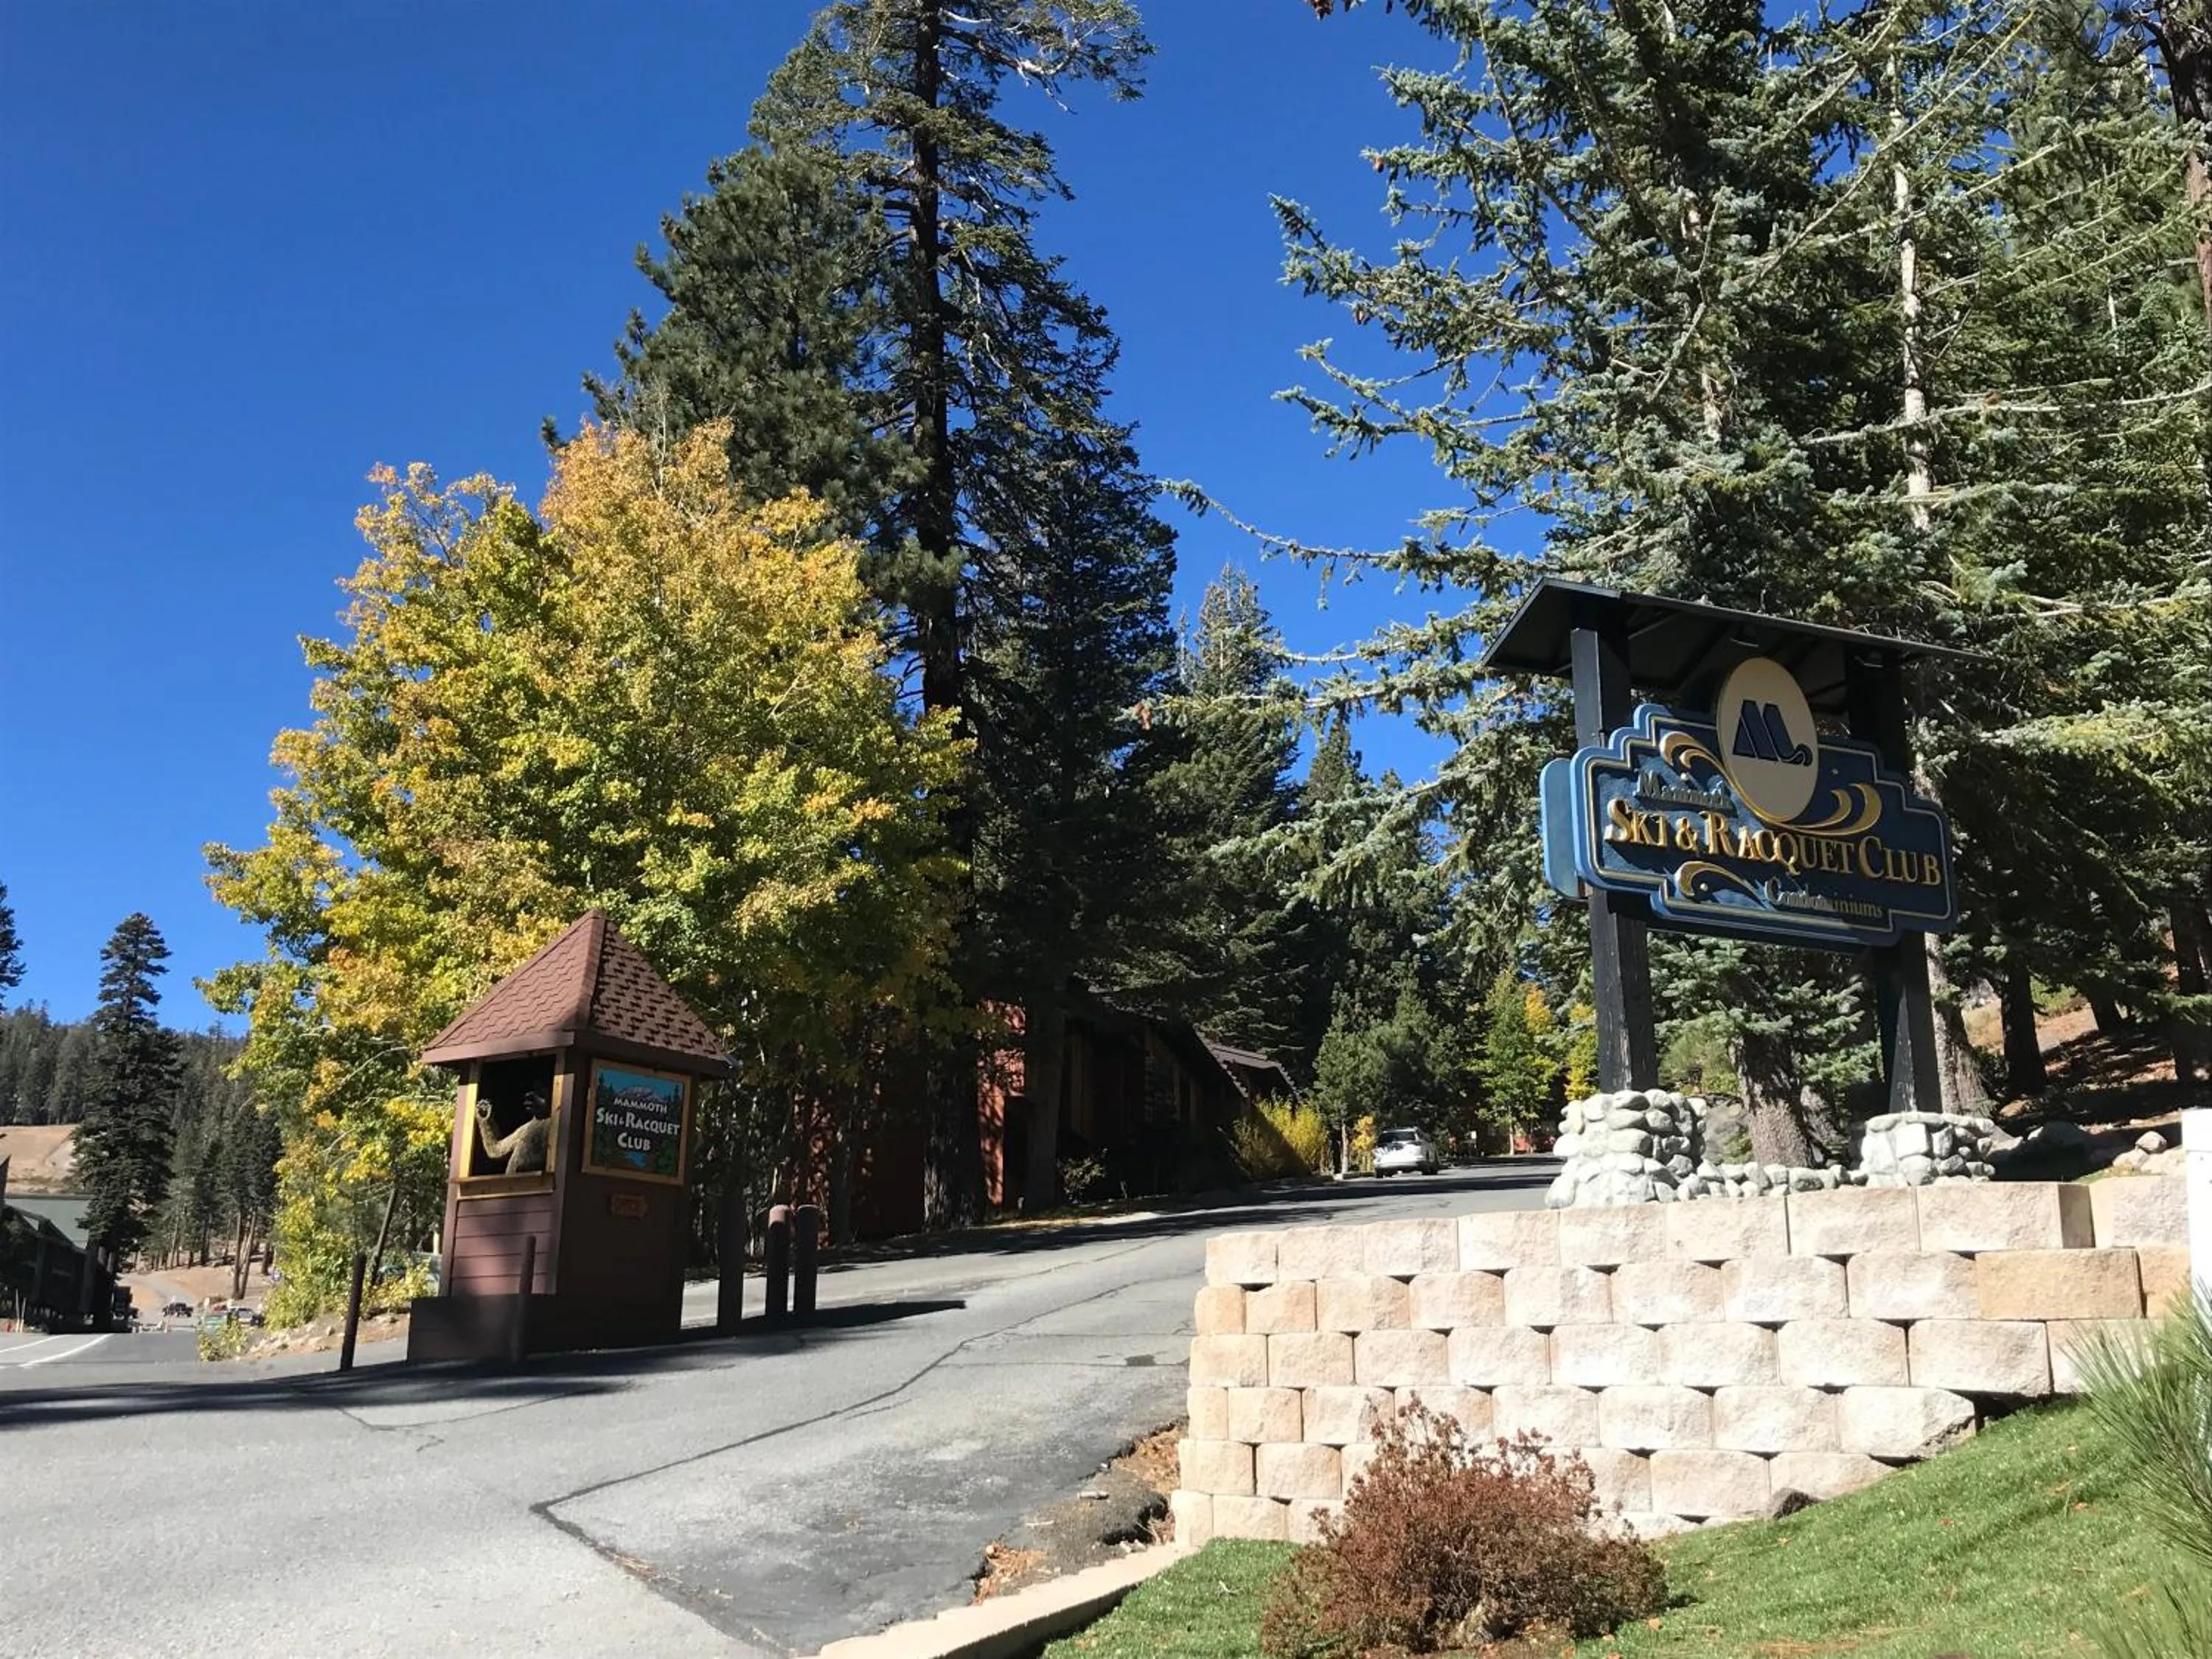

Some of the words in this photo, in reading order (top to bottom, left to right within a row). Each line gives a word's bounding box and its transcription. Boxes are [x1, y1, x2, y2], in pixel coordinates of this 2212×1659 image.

[1604, 799, 1668, 849] SKI
[1675, 816, 1698, 852] &
[1699, 811, 1854, 875] RACQUET
[1858, 835, 1942, 886] CLUB
[613, 1097, 668, 1114] MAMMOTH
[596, 1107, 619, 1126] SKI
[625, 1111, 681, 1135] RACQUET
[617, 1132, 652, 1151] CLUB
